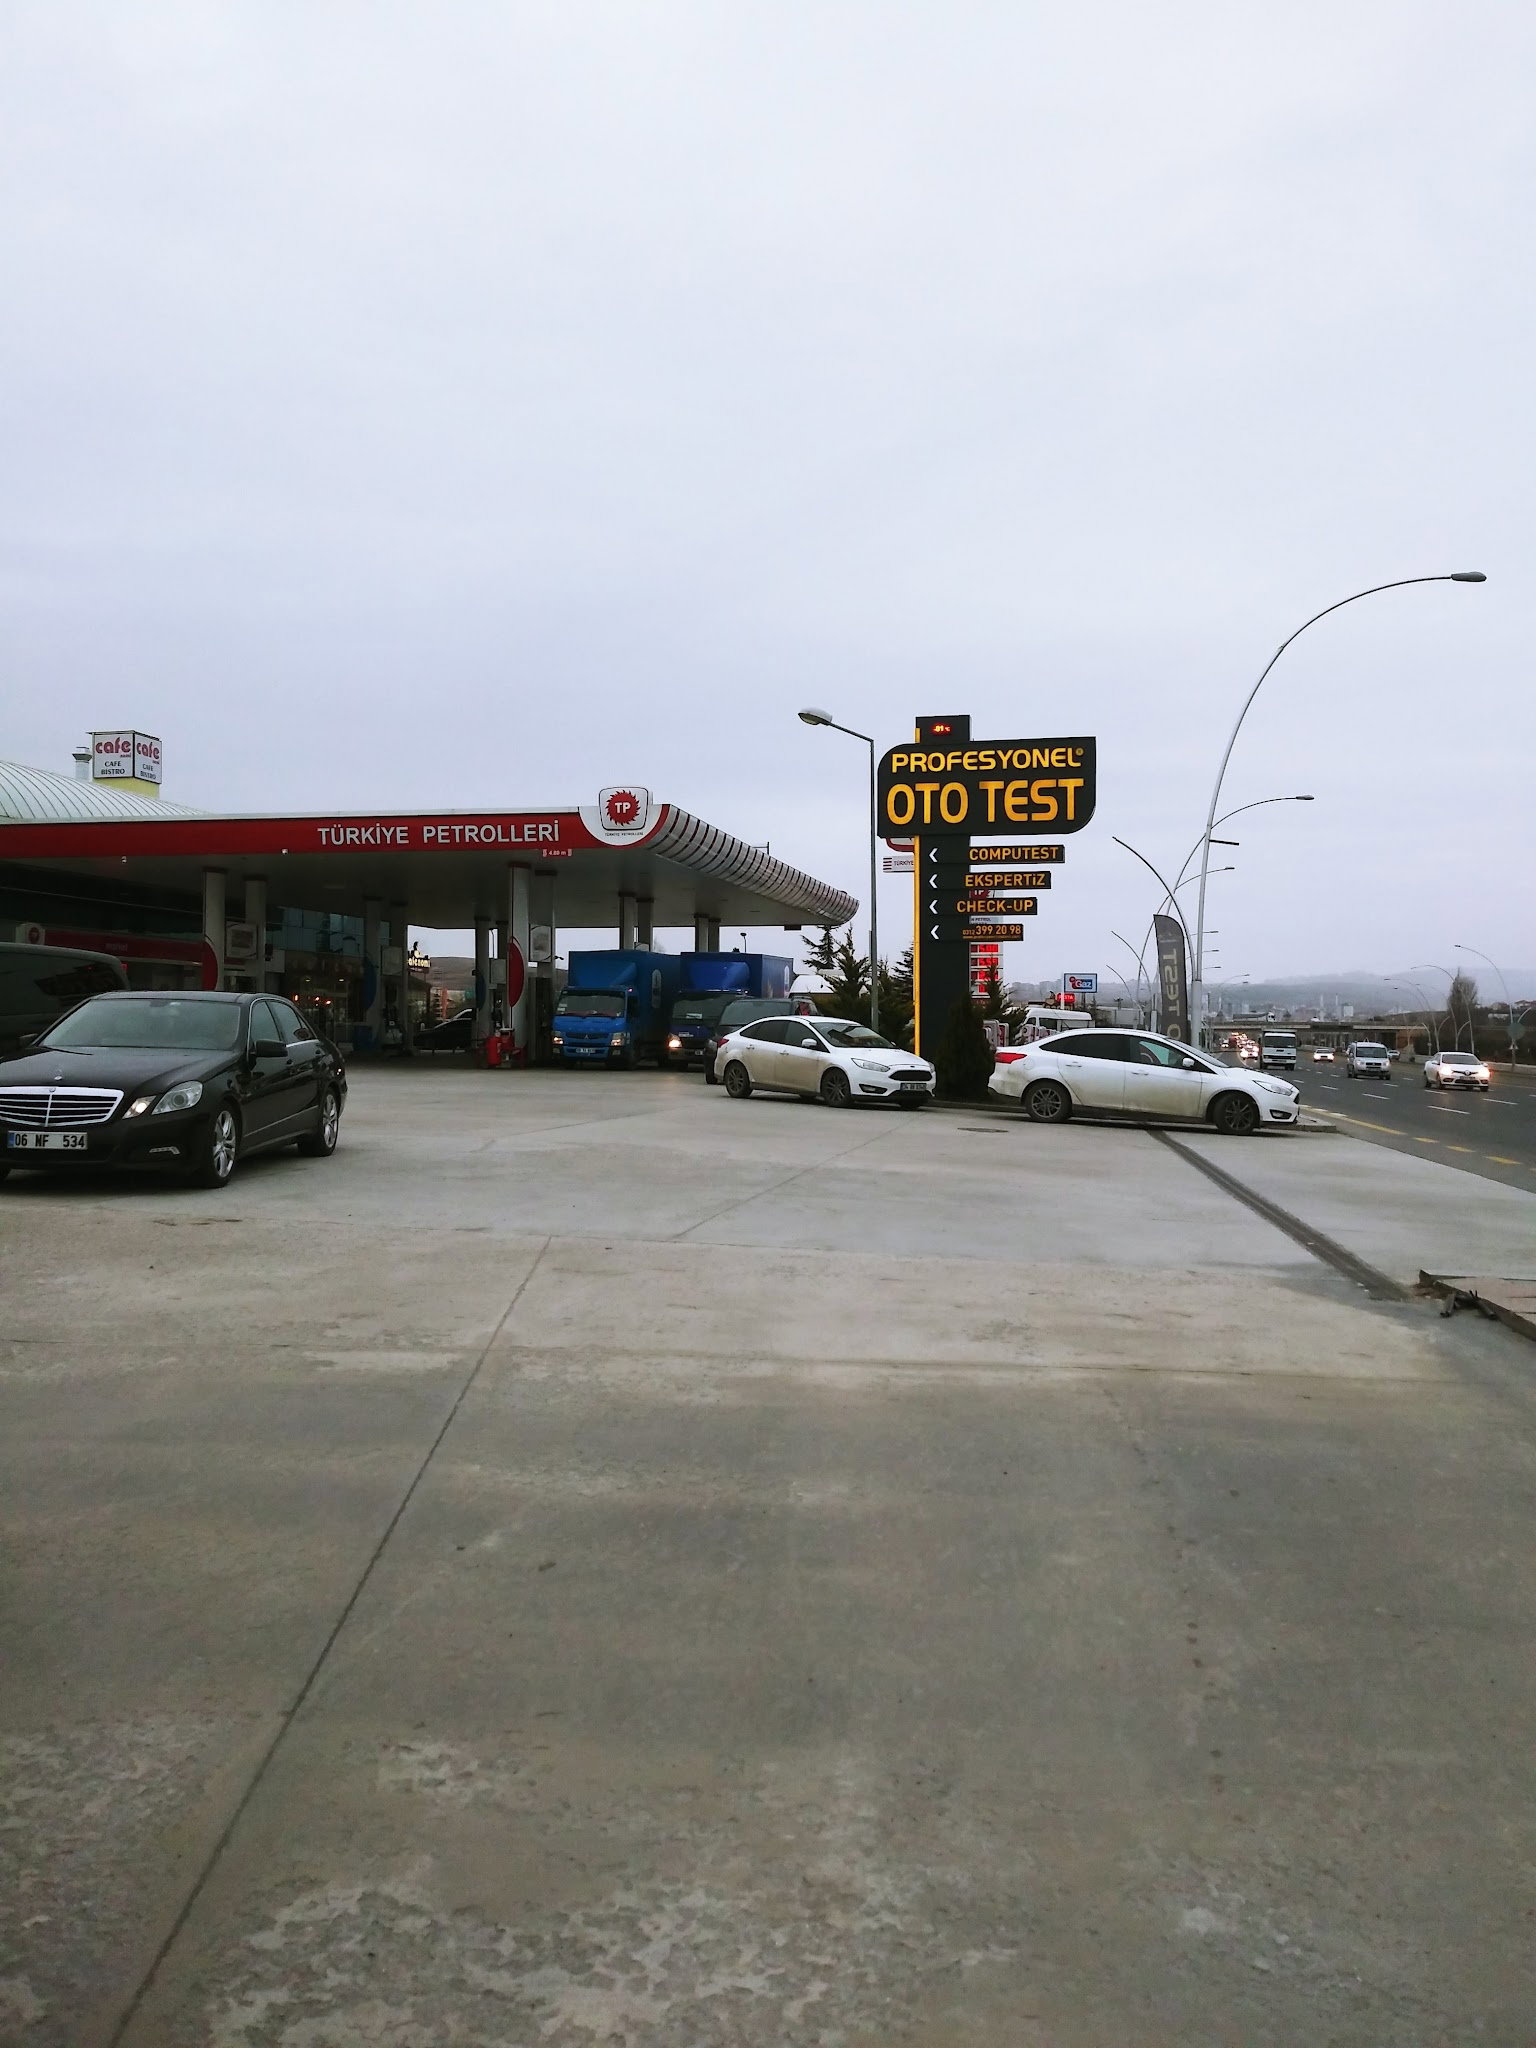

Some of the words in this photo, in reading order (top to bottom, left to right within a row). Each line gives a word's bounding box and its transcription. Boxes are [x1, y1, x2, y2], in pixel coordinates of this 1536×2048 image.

[96, 737, 131, 753] cafe
[137, 742, 159, 759] cafe
[892, 748, 1081, 773] PROFESYONEL
[615, 802, 632, 814] TP
[887, 783, 968, 824] OTO
[979, 778, 1084, 822] TEST
[317, 823, 409, 845] TÜRKİYE
[423, 820, 560, 843] PETROLLERİ
[969, 847, 1059, 861] COMPUTEST
[956, 899, 1034, 913] CHECK-UP
[976, 925, 993, 935] 399
[996, 925, 1007, 935] 20
[1010, 925, 1021, 935] 98
[15, 1134, 27, 1146] 06
[35, 1134, 49, 1147] NF
[63, 1136, 85, 1147] 534
